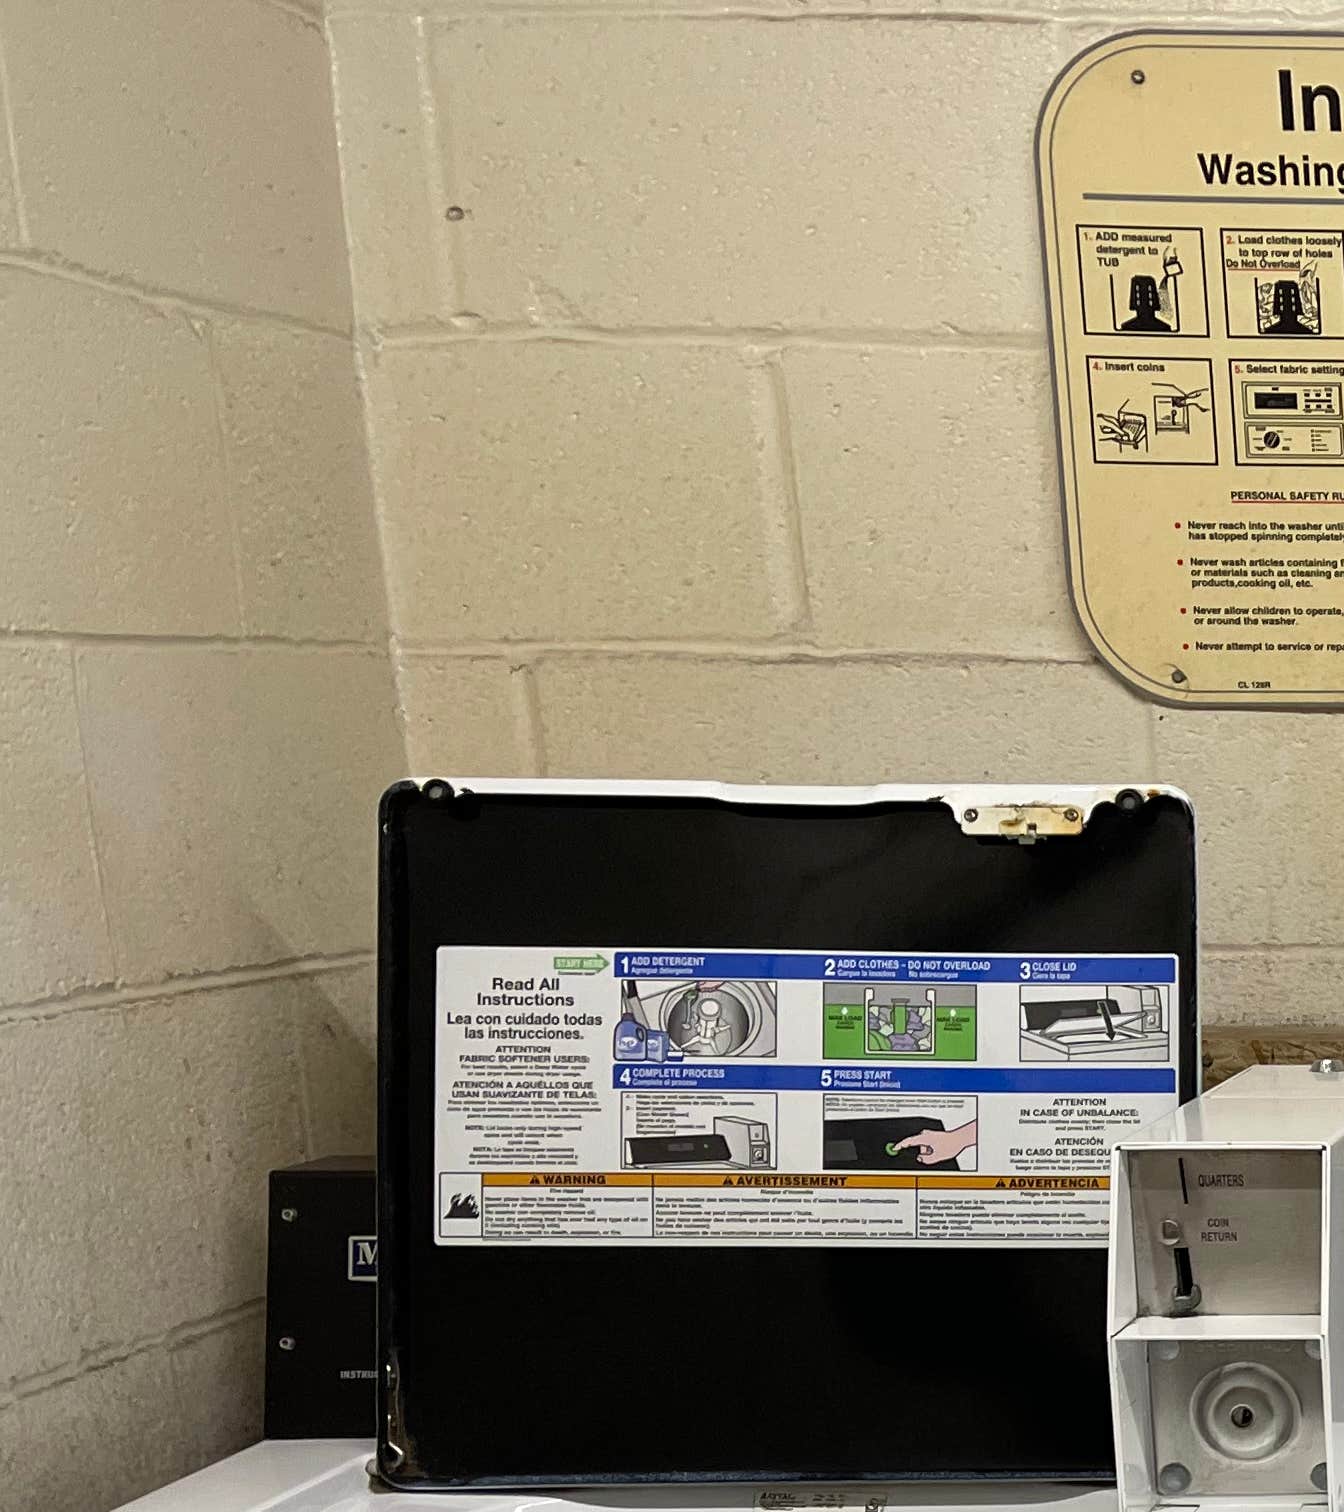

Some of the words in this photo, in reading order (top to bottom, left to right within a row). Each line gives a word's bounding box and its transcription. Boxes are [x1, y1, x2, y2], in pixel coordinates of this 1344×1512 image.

[1096, 233, 1119, 242] ADD
[1122, 233, 1172, 244] measured
[1238, 236, 1263, 245] Load
[1266, 236, 1303, 246] clothes
[1306, 236, 1342, 249] loosely
[1096, 245, 1144, 257] detergent
[1148, 246, 1158, 256] to
[1239, 248, 1249, 258] to
[1252, 249, 1268, 261] top
[1271, 250, 1290, 258] row
[1293, 248, 1303, 258] of
[1305, 248, 1333, 258] holes
[1097, 257, 1120, 267] TUB
[1226, 259, 1238, 269] Do
[1241, 260, 1257, 269] Not
[1260, 260, 1300, 269] Overload
[1105, 362, 1134, 372] Insert
[1137, 363, 1165, 372] coins
[1246, 365, 1276, 374] Select
[1279, 365, 1309, 375] fabric
[1311, 365, 1344, 377] setting
[1231, 491, 1286, 501] PERSONAL
[1290, 492, 1329, 501] SAFETY
[492, 977, 534, 991] Read
[538, 977, 560, 991] All
[477, 992, 575, 1007] Instructions
[447, 1012, 471, 1026] Lea
[475, 1015, 501, 1026] con
[505, 1012, 560, 1026] cuidado
[563, 1012, 602, 1027] todas
[464, 1027, 484, 1040] las
[488, 1027, 584, 1040] instrucciones.
[543, 1175, 606, 1185] WARNING
[737, 1175, 847, 1187] AVERTISSEMENT
[1009, 1178, 1099, 1188] ADVERTENCIA
[1198, 1174, 1245, 1187] QUARTERS
[1207, 1218, 1229, 1227] COIN
[1201, 1232, 1238, 1242] RETURN
